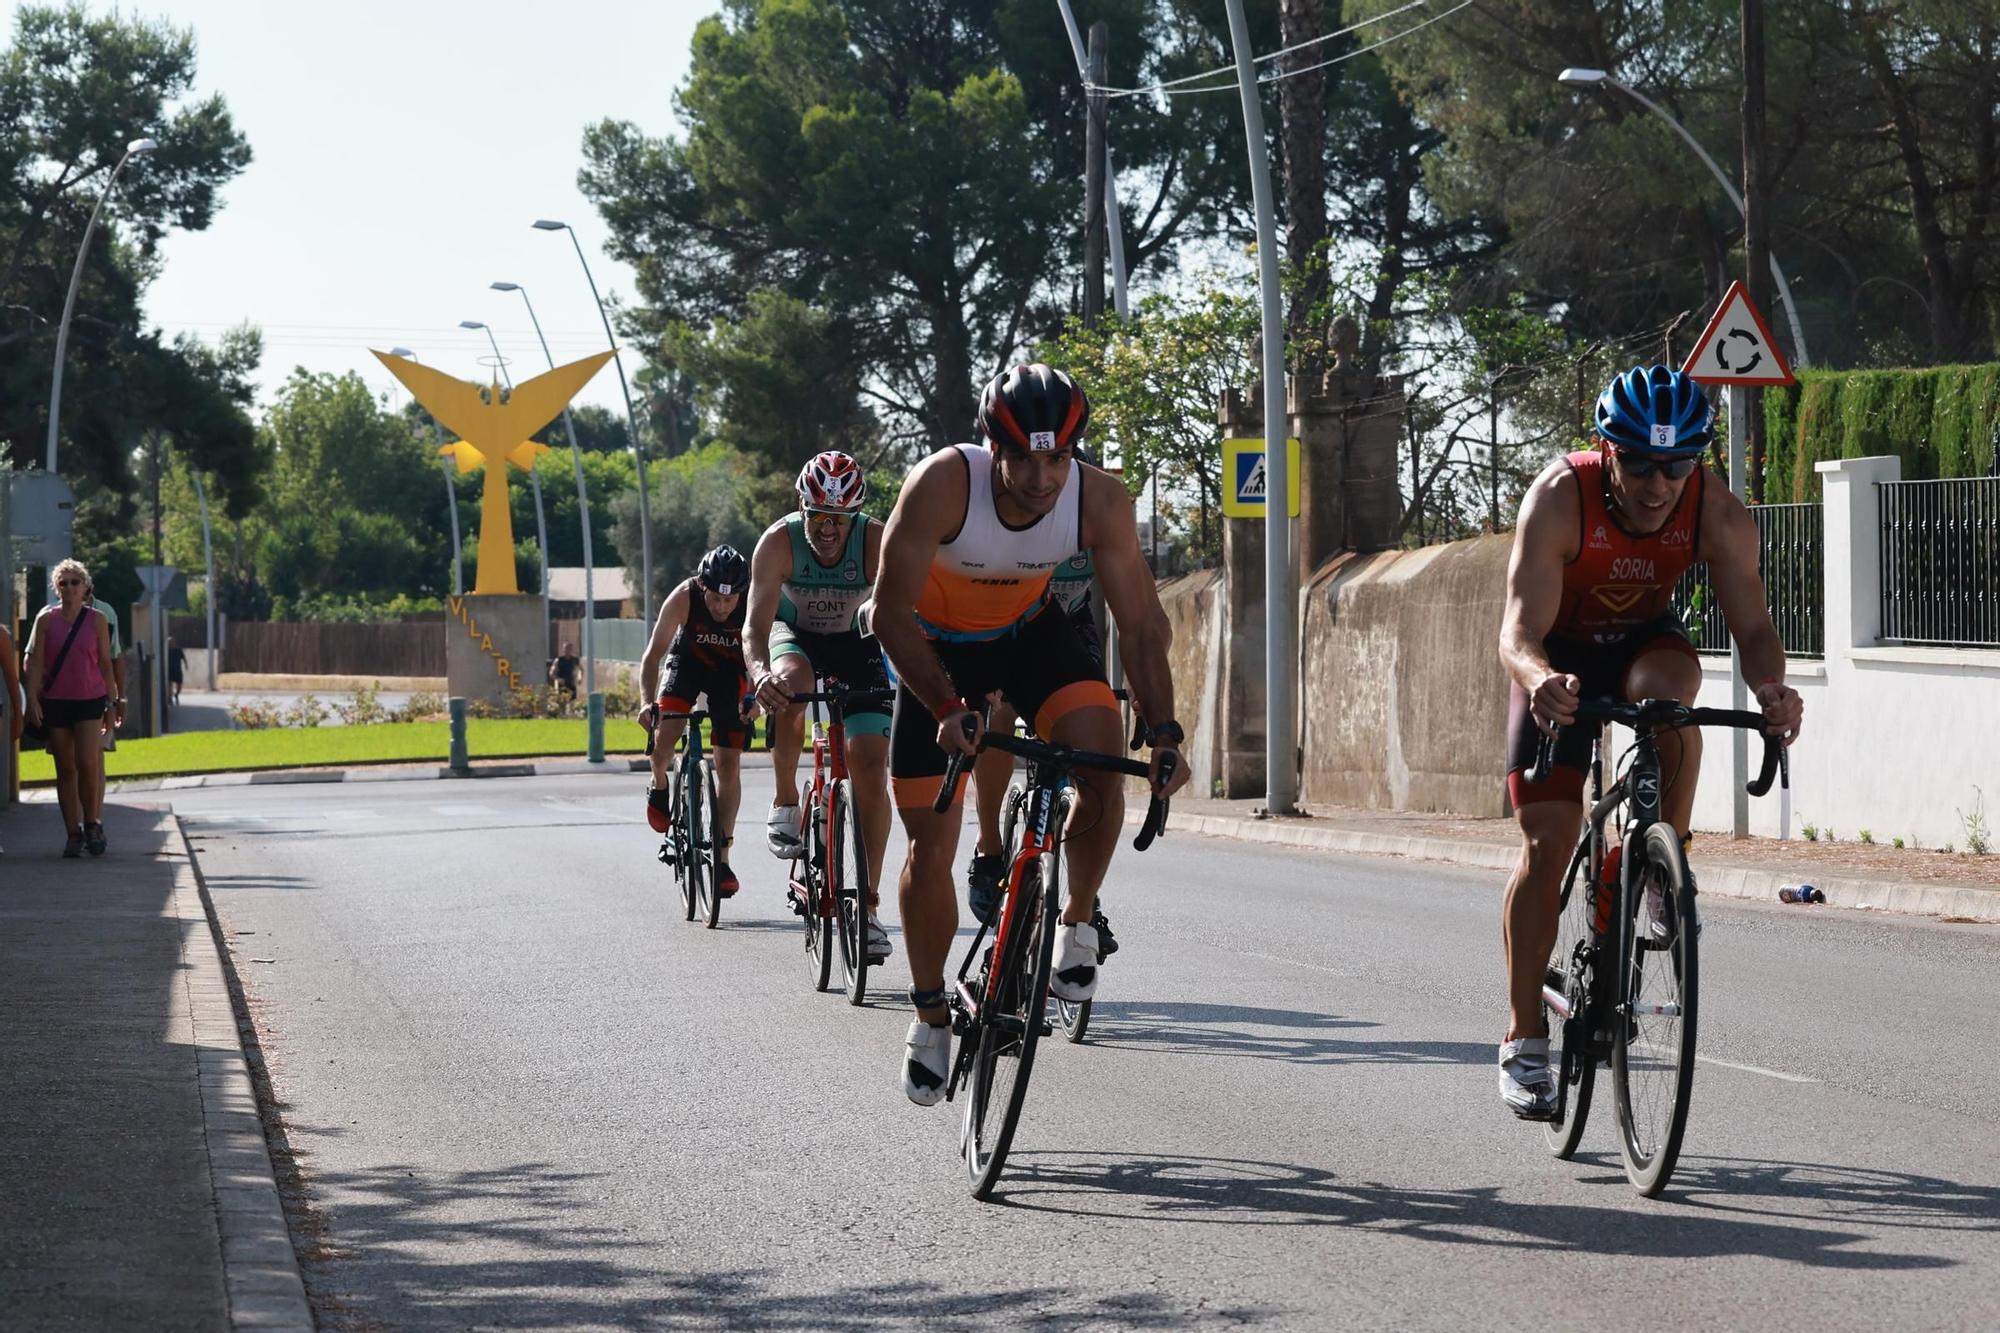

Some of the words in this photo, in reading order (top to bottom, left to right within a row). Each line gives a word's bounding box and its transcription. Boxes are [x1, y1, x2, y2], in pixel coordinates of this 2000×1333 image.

[1036, 441, 1050, 449] 43
[1660, 434, 1667, 444] 9
[1609, 557, 1655, 580] SORIA
[807, 600, 847, 613] FONT
[696, 633, 739, 647] ZABALA
